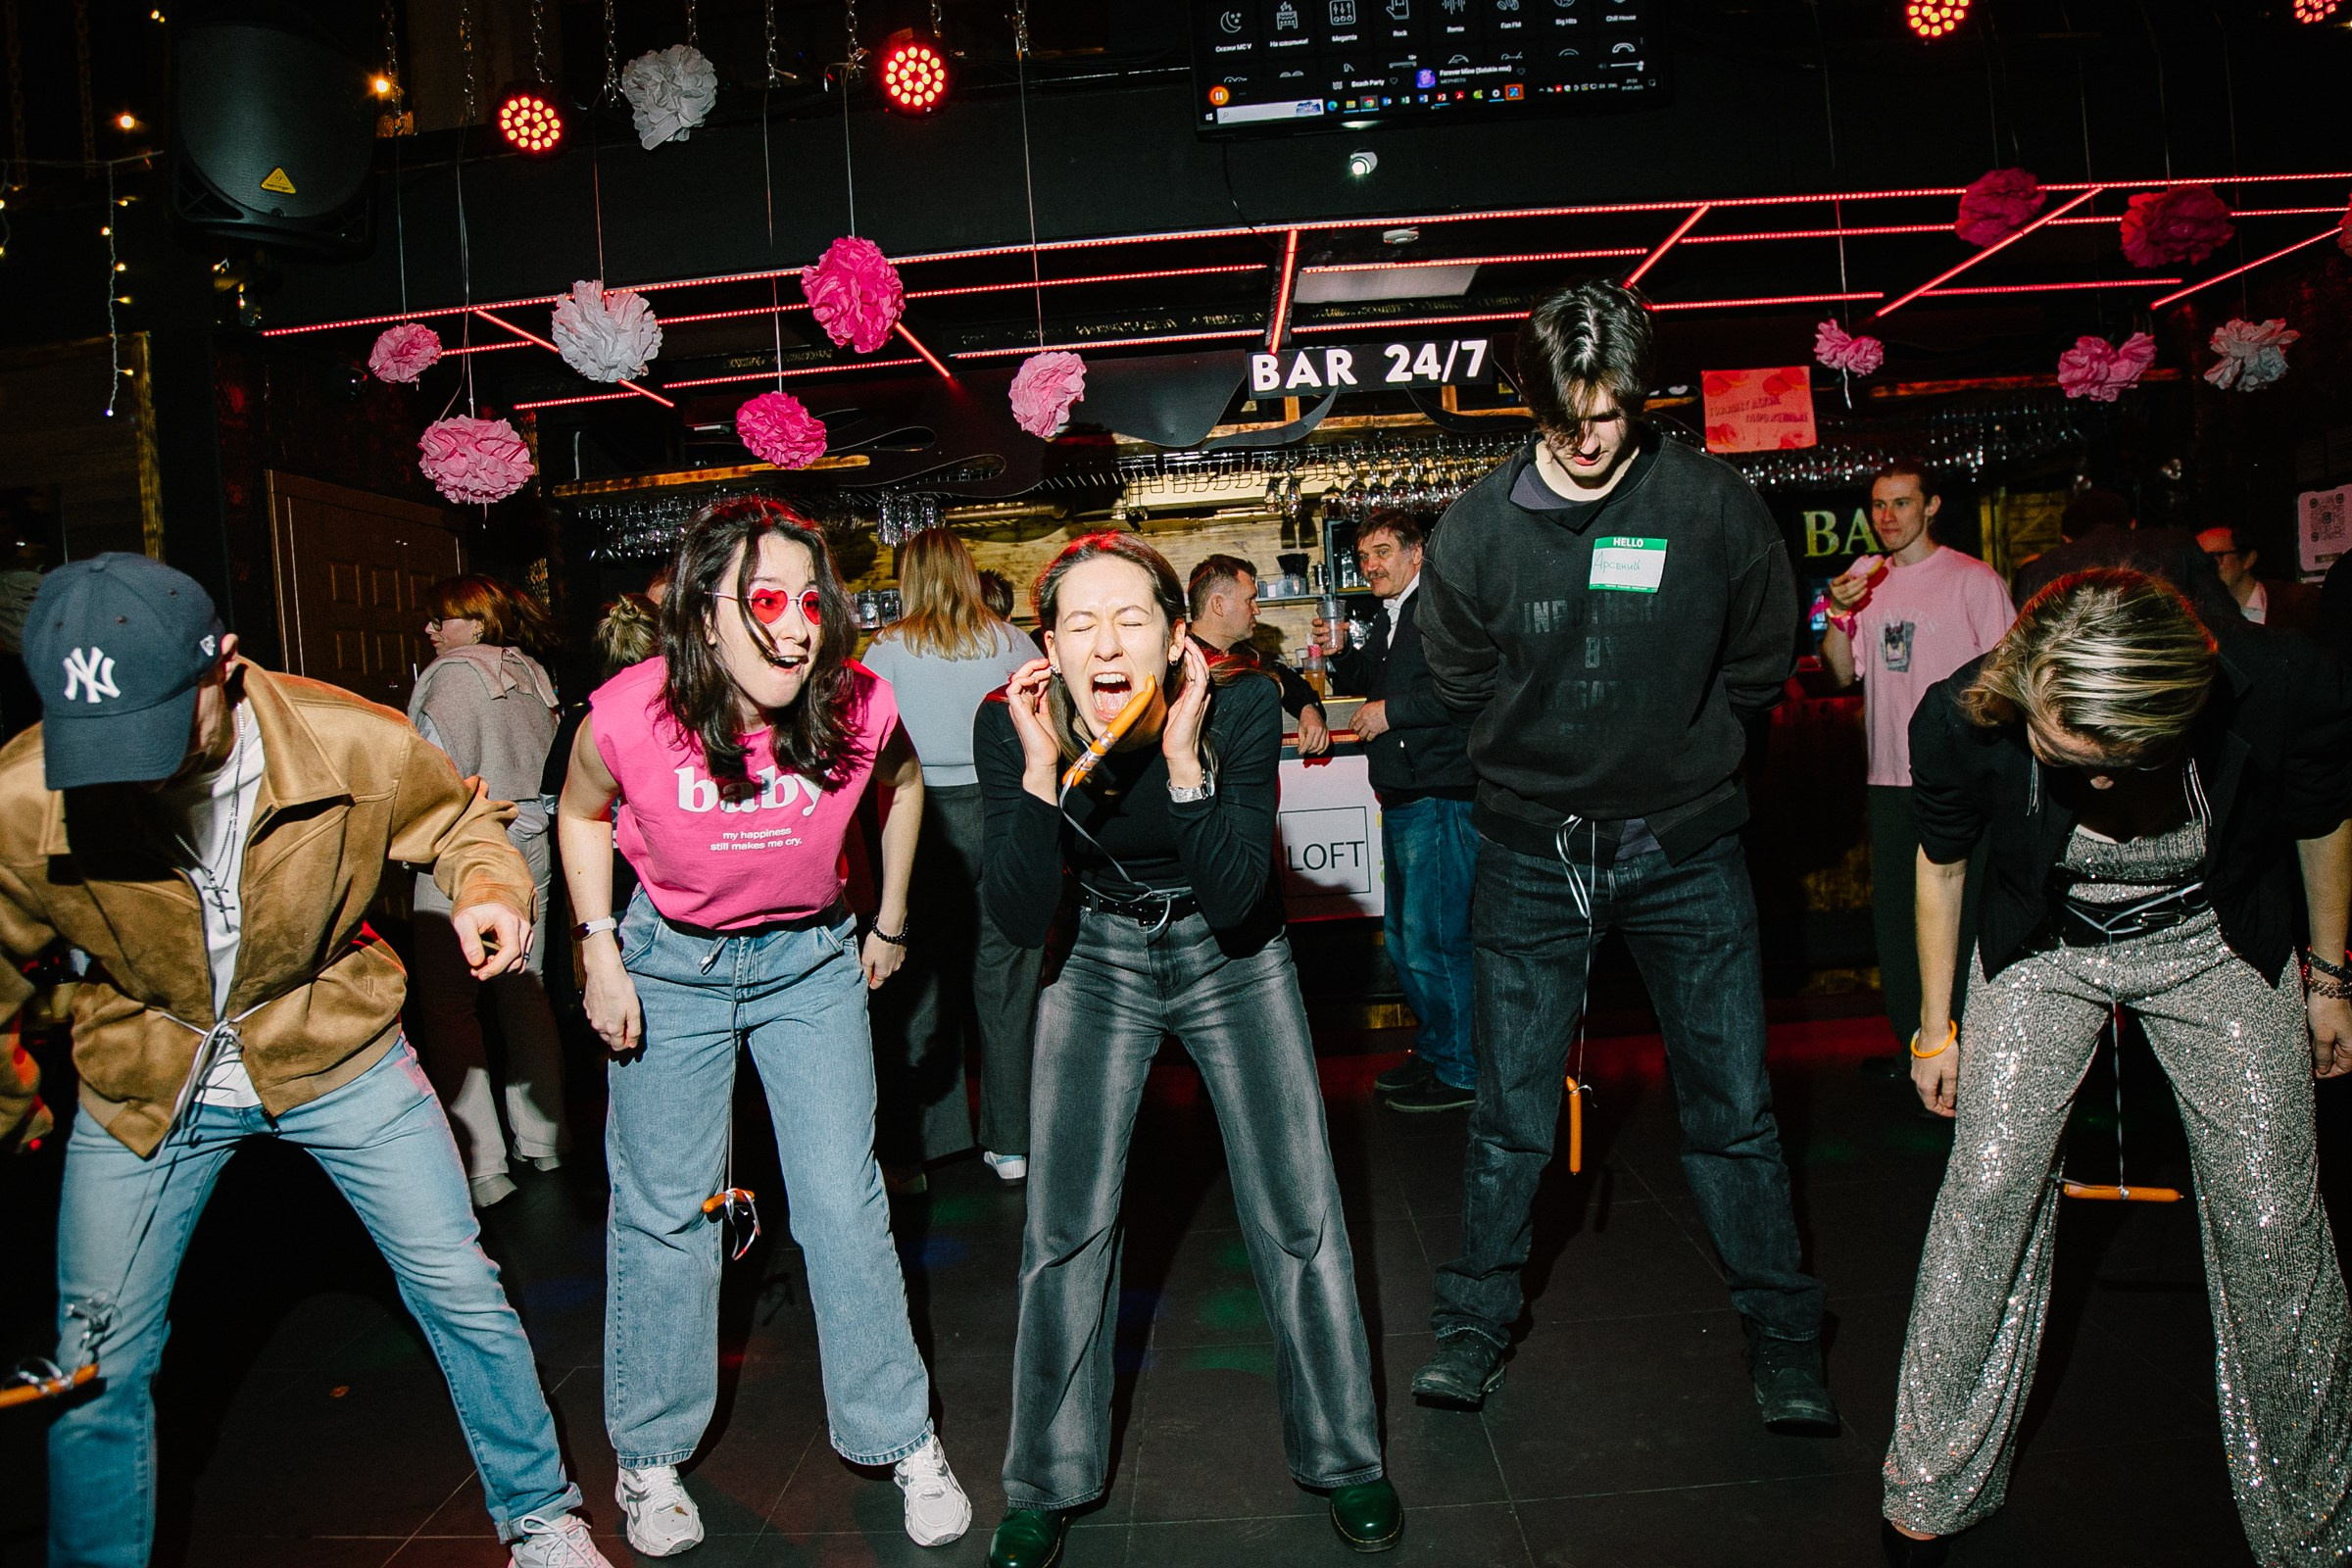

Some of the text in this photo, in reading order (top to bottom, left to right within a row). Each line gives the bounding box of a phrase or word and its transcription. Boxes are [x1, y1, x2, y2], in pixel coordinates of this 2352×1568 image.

[1369, 78, 1385, 87] Party
[1252, 340, 1488, 391] BAR 24/7
[1613, 537, 1644, 548] HELLO
[674, 765, 833, 817] baby
[722, 827, 793, 841] my happiness
[710, 842, 729, 852] still
[731, 841, 765, 851] makes
[785, 837, 803, 847] cry.
[1287, 840, 1365, 872] LOFT
